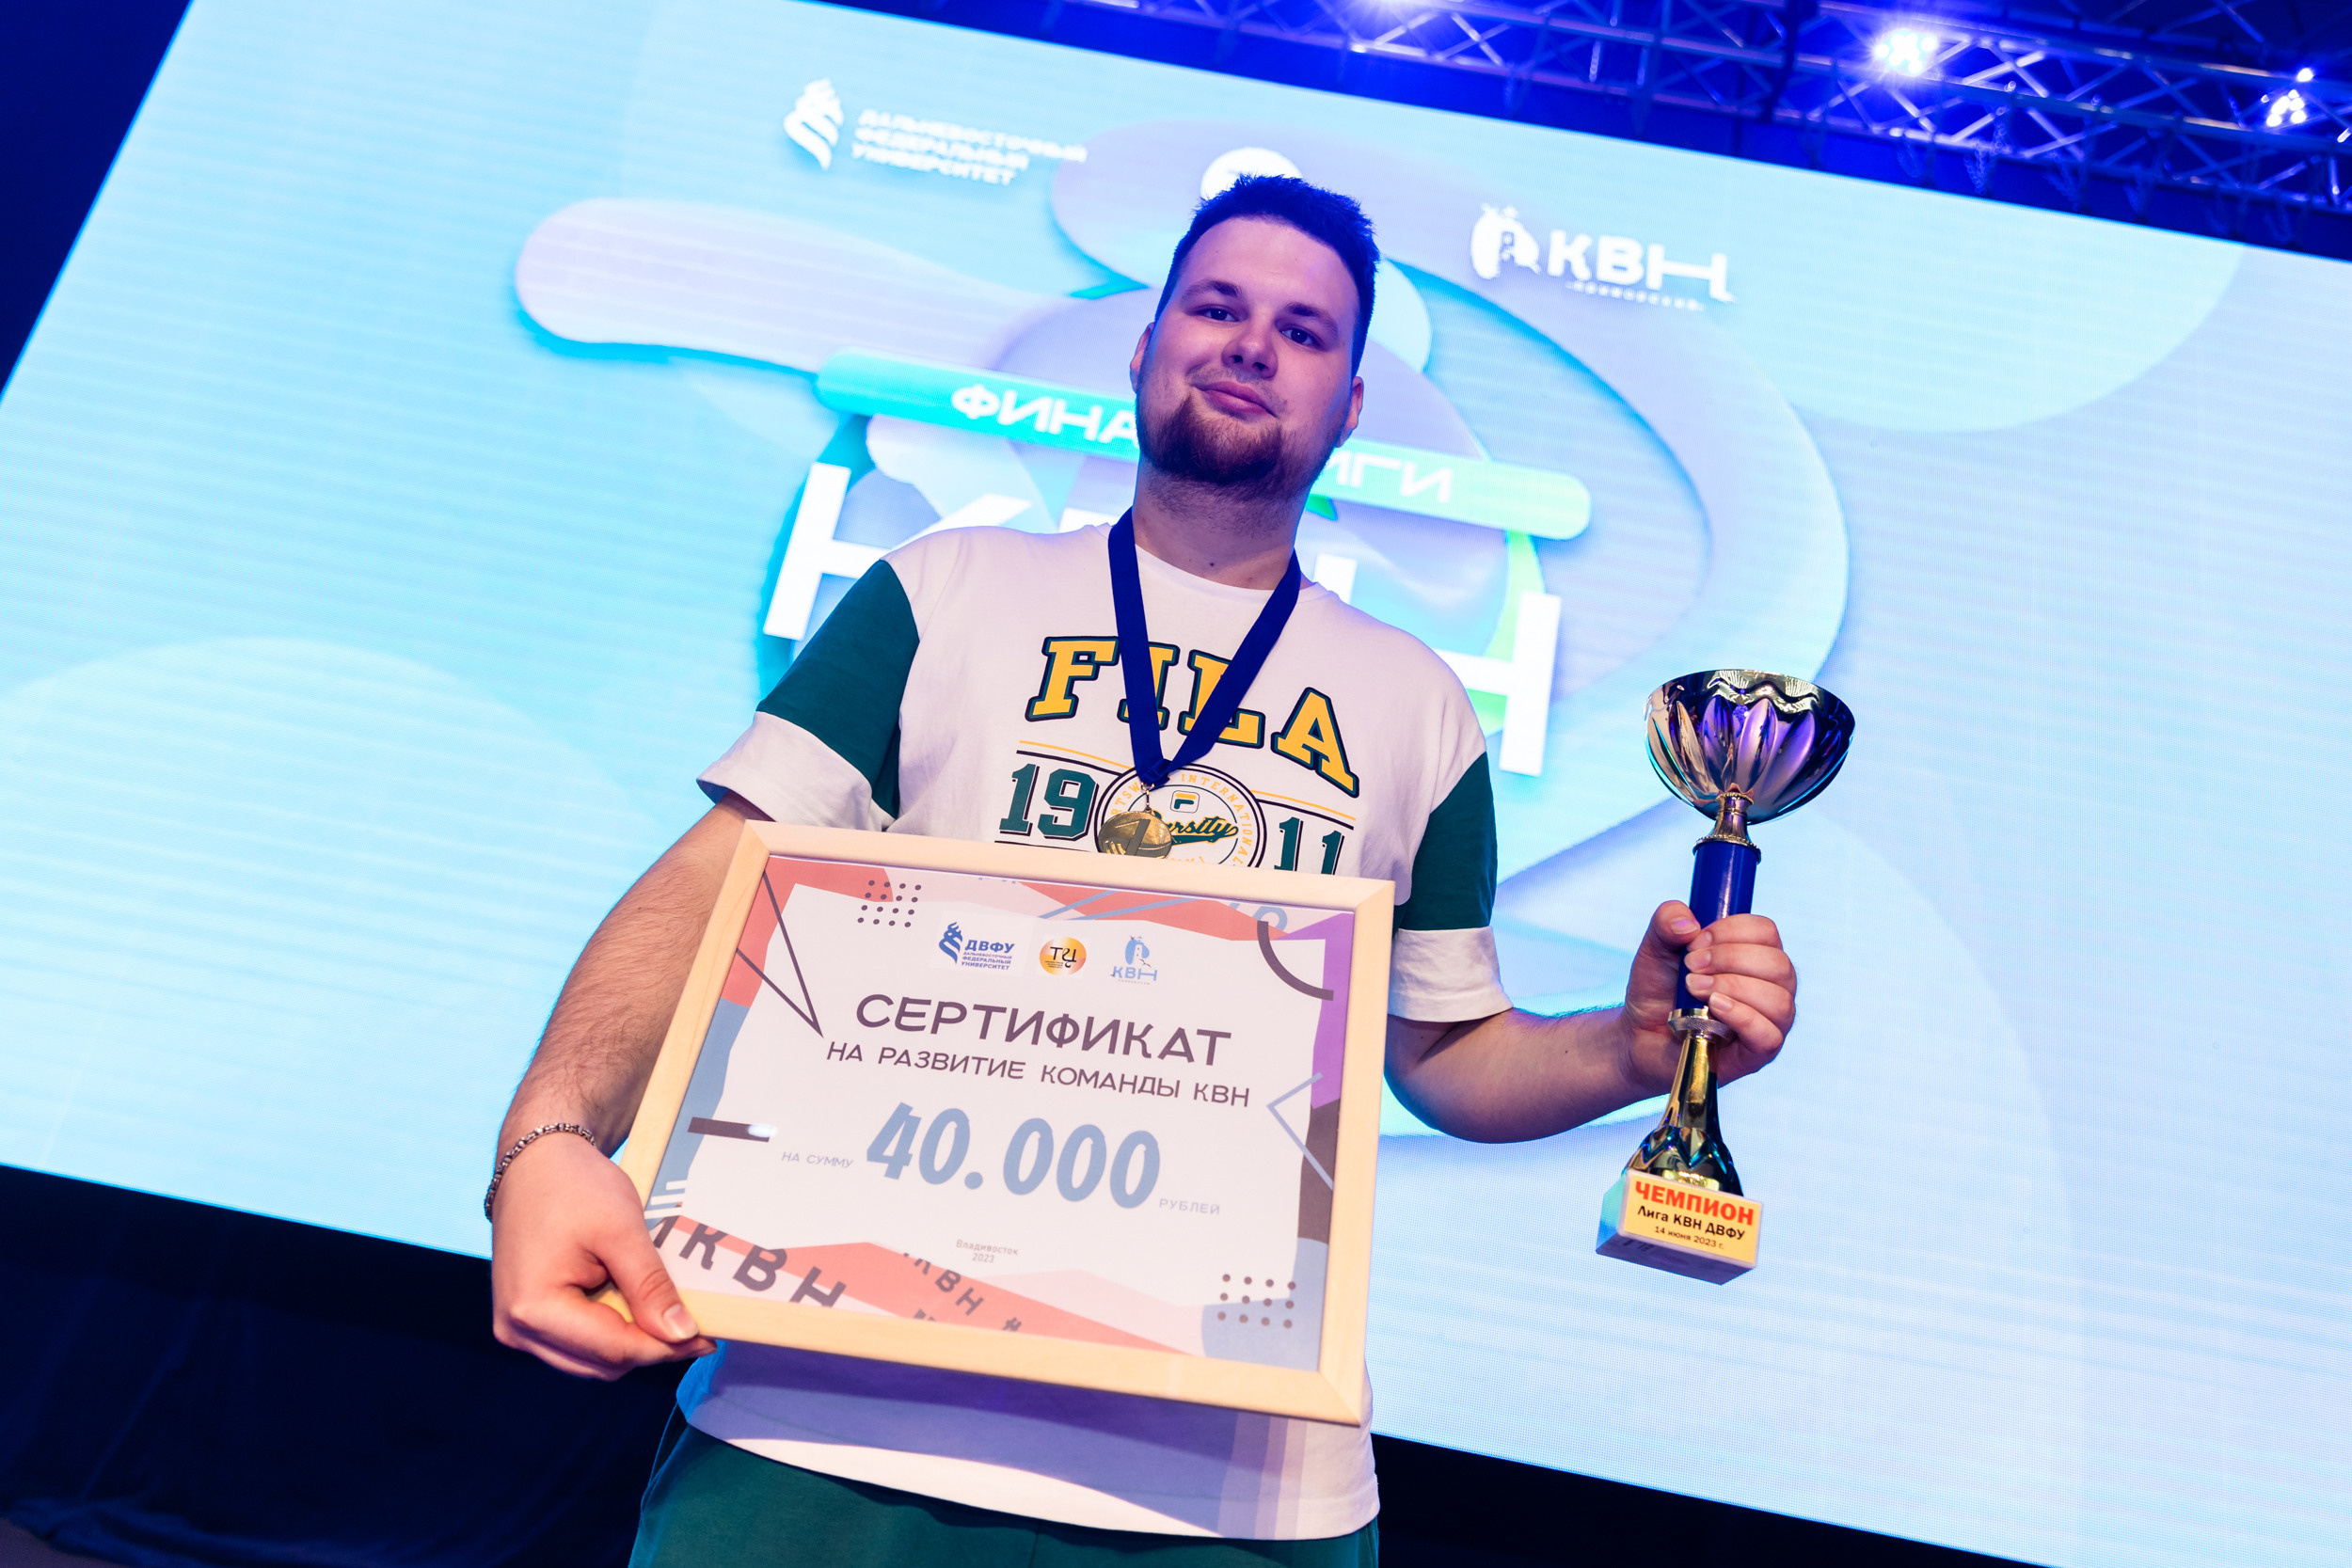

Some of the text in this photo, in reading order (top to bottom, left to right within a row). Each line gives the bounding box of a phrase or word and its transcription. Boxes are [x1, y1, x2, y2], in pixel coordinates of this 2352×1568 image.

[1547, 230, 1737, 303] КВН
[951, 384, 1140, 449] ФИНА
[1181, 773, 1253, 865] INTERNATIONAL
[961, 956, 1011, 965] ФЕДЕРАЛЬНЫЙ
[964, 940, 1015, 954] ДВФУ
[961, 961, 1009, 970] УНИВЕРСИТЕТ
[1113, 966, 1158, 981] КВН
[856, 993, 1232, 1066] СЕРТИФИКАТ
[826, 1040, 1250, 1108] НА РАЗВИТИЕ КОМАНДЫ КВН
[781, 1101, 1220, 1215] НА СУММУ 40.000 РУБЛЕЙ
[1634, 1180, 1755, 1227] ЧЕМПИОН
[1637, 1205, 1746, 1241] Лига КВН ДВФУ
[1654, 1226, 1665, 1234] 14
[1667, 1230, 1692, 1242] июня
[1693, 1235, 1717, 1248] 2023
[955, 1239, 1019, 1256] Владивосток
[972, 1252, 995, 1264] 2023
